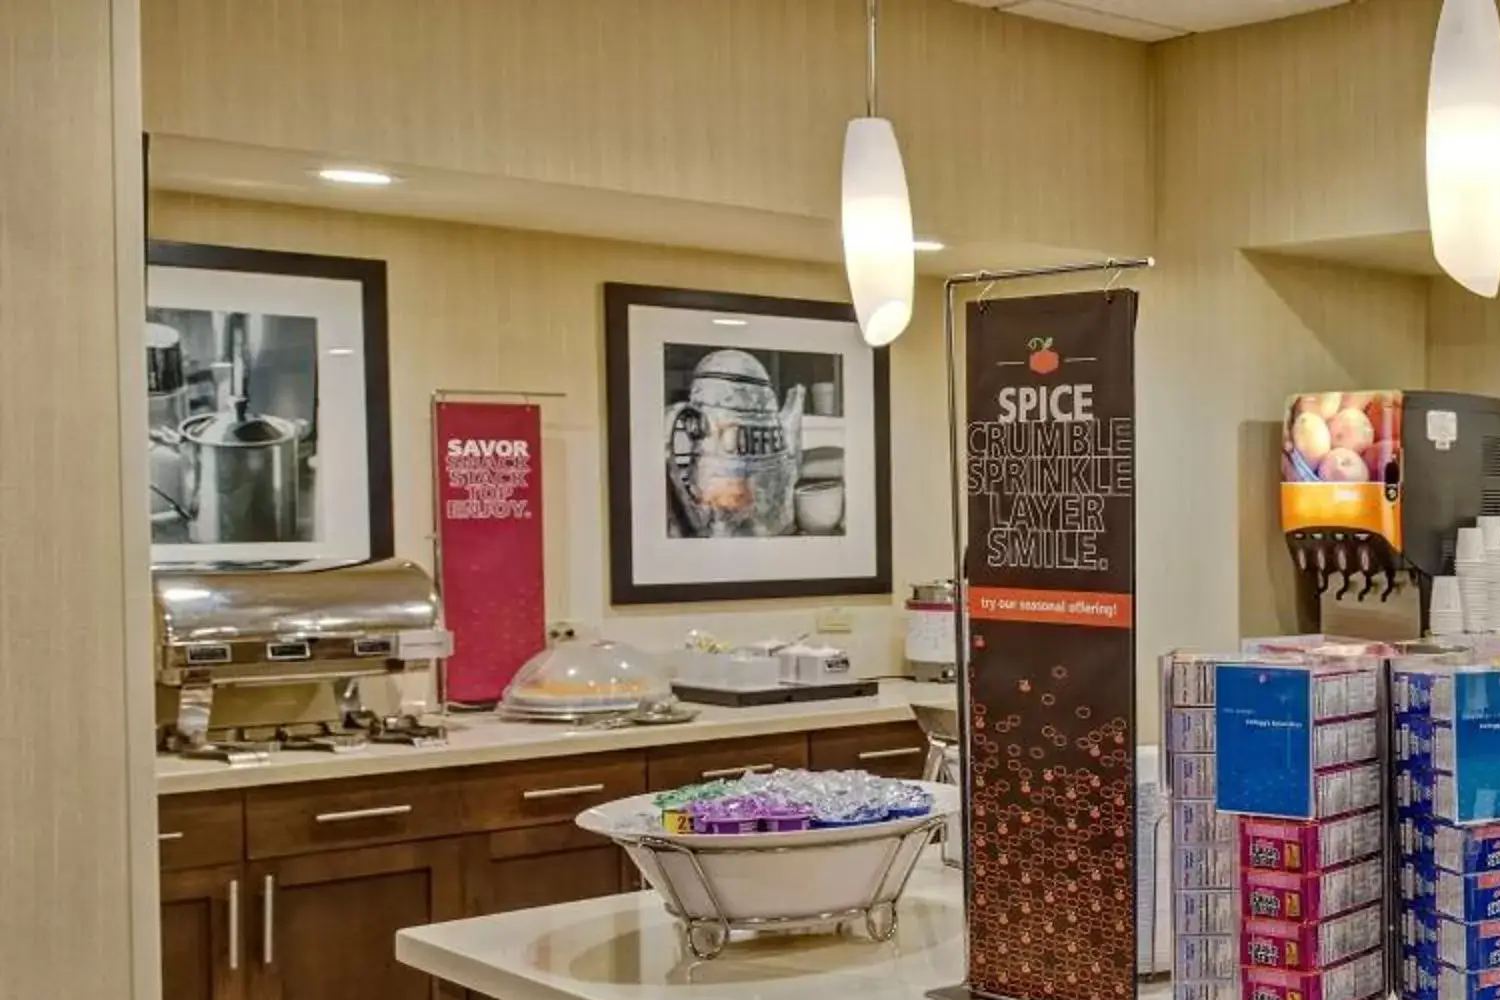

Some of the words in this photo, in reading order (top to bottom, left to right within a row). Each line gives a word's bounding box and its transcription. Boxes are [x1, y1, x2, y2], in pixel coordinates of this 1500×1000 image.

[998, 384, 1094, 424] SPICE
[447, 439, 529, 457] SAVOR
[968, 418, 1132, 458] CRUMBLE
[968, 457, 1132, 496] SPRINKLE
[990, 494, 1106, 532] LAYER
[987, 528, 1109, 570] SMILE.
[980, 596, 996, 612] try
[997, 598, 1016, 609] our
[1019, 600, 1066, 613] seasonal
[1068, 601, 1117, 618] offering!
